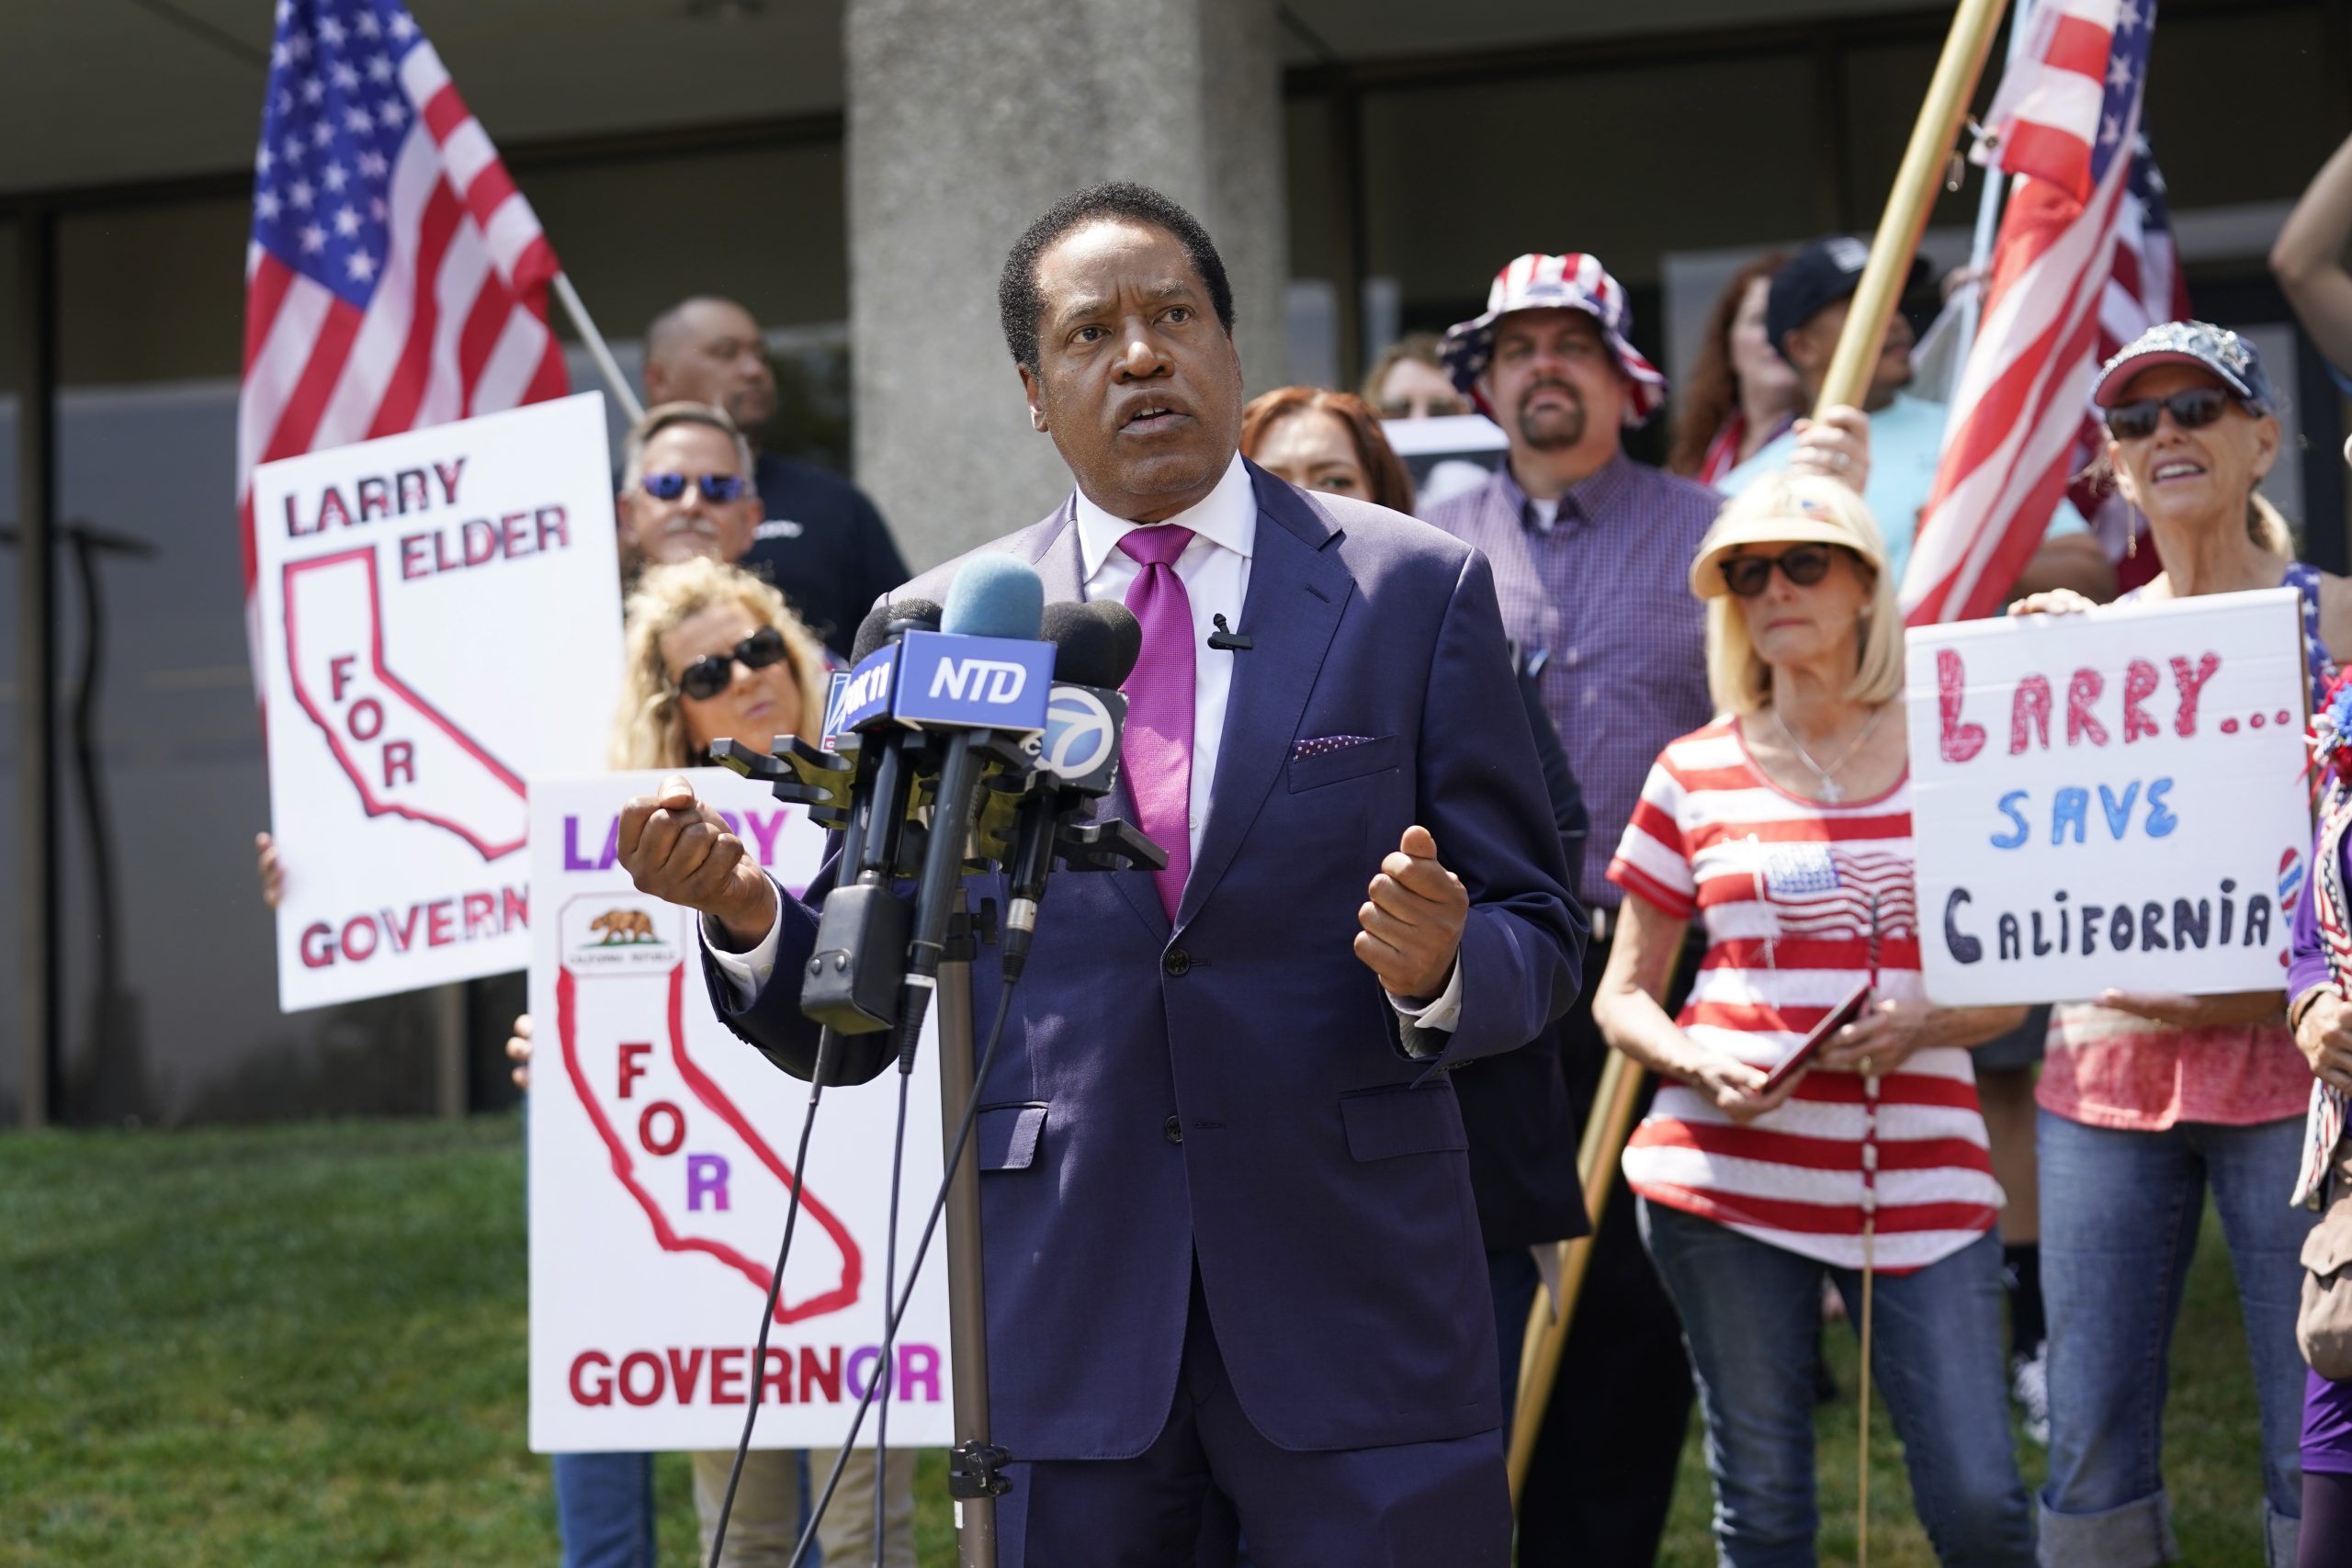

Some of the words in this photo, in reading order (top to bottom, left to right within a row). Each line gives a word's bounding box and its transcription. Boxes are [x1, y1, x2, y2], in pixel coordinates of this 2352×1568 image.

[284, 458, 467, 539] LARRY
[401, 504, 571, 581] ELDER
[929, 657, 1026, 704] NTD
[1990, 777, 2177, 849] SAVE
[568, 1344, 943, 1407] GOVERNOR
